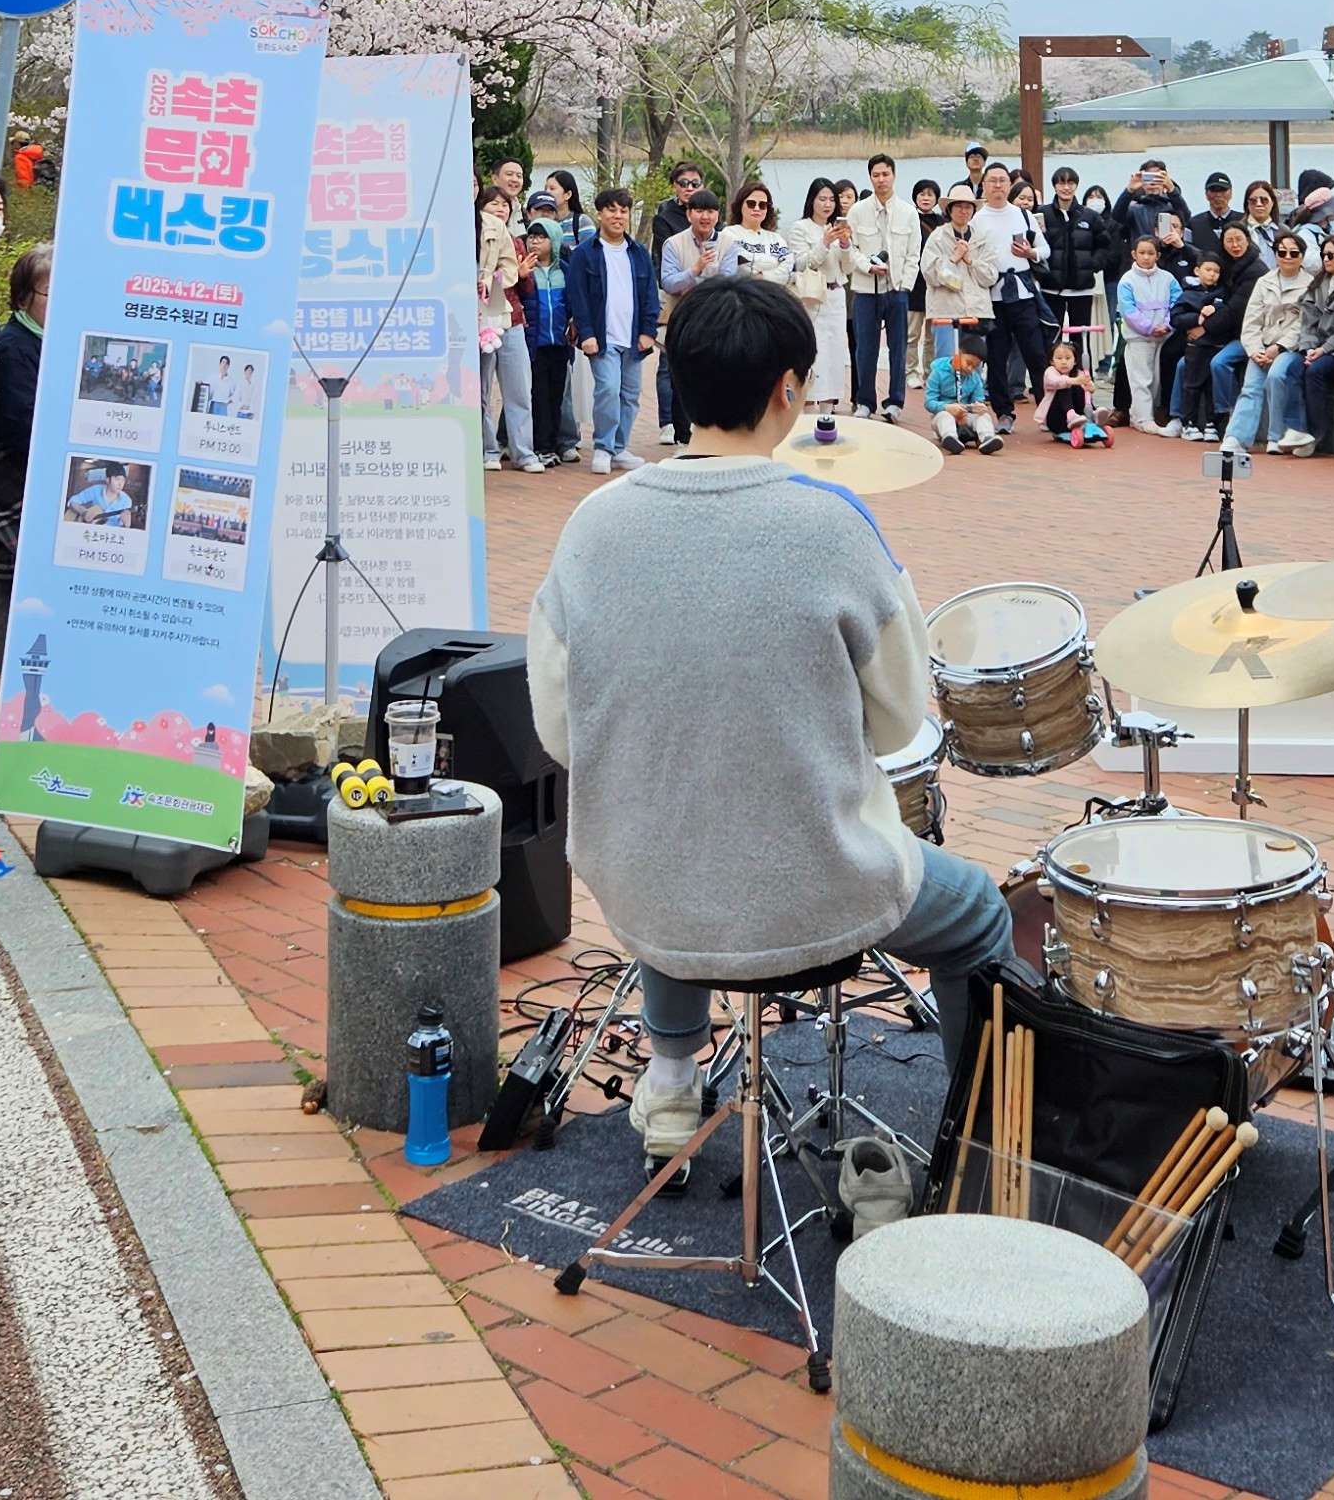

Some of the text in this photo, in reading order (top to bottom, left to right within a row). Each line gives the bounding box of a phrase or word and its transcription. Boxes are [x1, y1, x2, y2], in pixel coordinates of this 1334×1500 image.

[250, 22, 306, 42] SOKCHO
[149, 73, 168, 117] 2025
[170, 77, 258, 126] 속초
[144, 127, 250, 188] 문화
[113, 185, 269, 252] 버스킹
[124, 301, 239, 329] 영랑호수윗길 데크
[94, 426, 139, 441] AM 11:00
[199, 439, 242, 454] PM 13:00
[78, 549, 124, 564] PM 15:00
[187, 563, 202, 575] PM
[522, 1187, 599, 1216] BEAT
